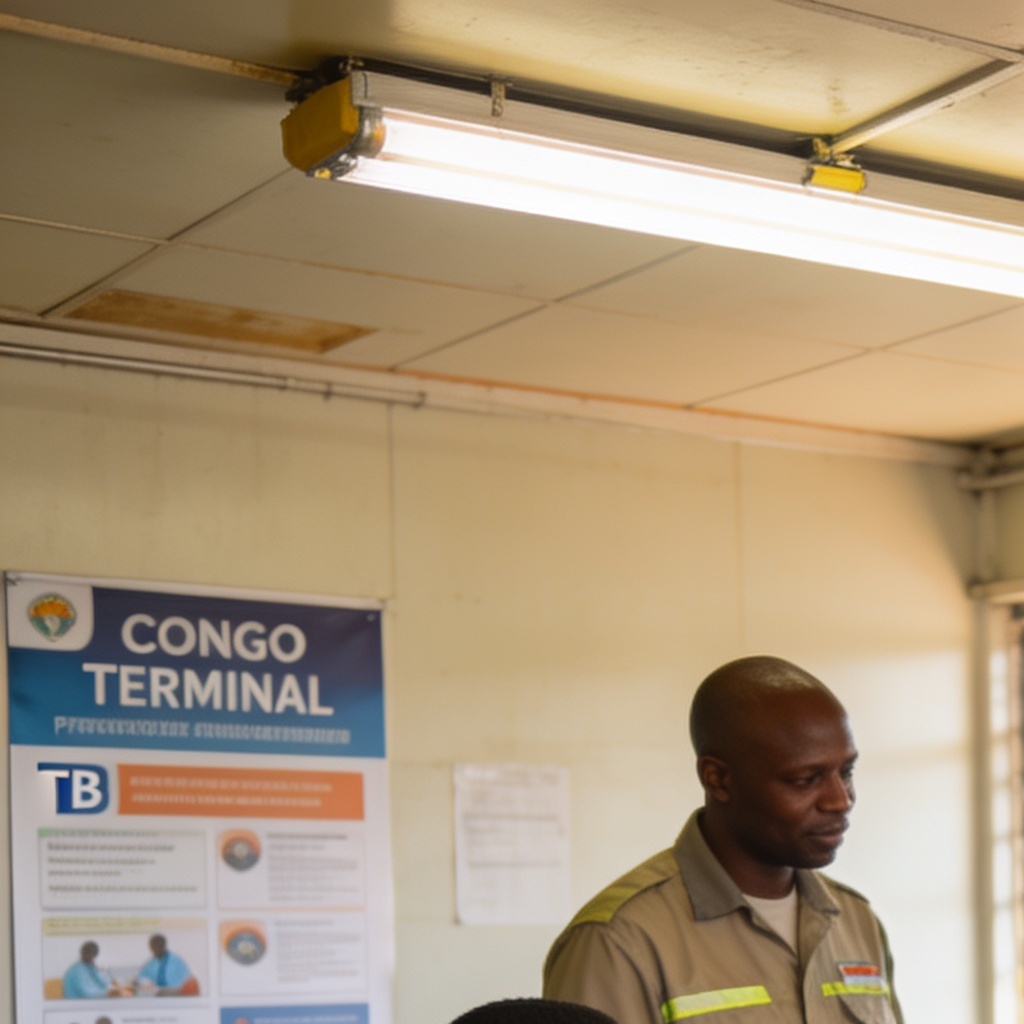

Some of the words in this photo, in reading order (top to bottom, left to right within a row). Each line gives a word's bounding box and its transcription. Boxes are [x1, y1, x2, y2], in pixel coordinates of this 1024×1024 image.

[120, 613, 307, 663] CONGO
[82, 662, 334, 716] TERMINAL
[38, 769, 102, 810] TB
